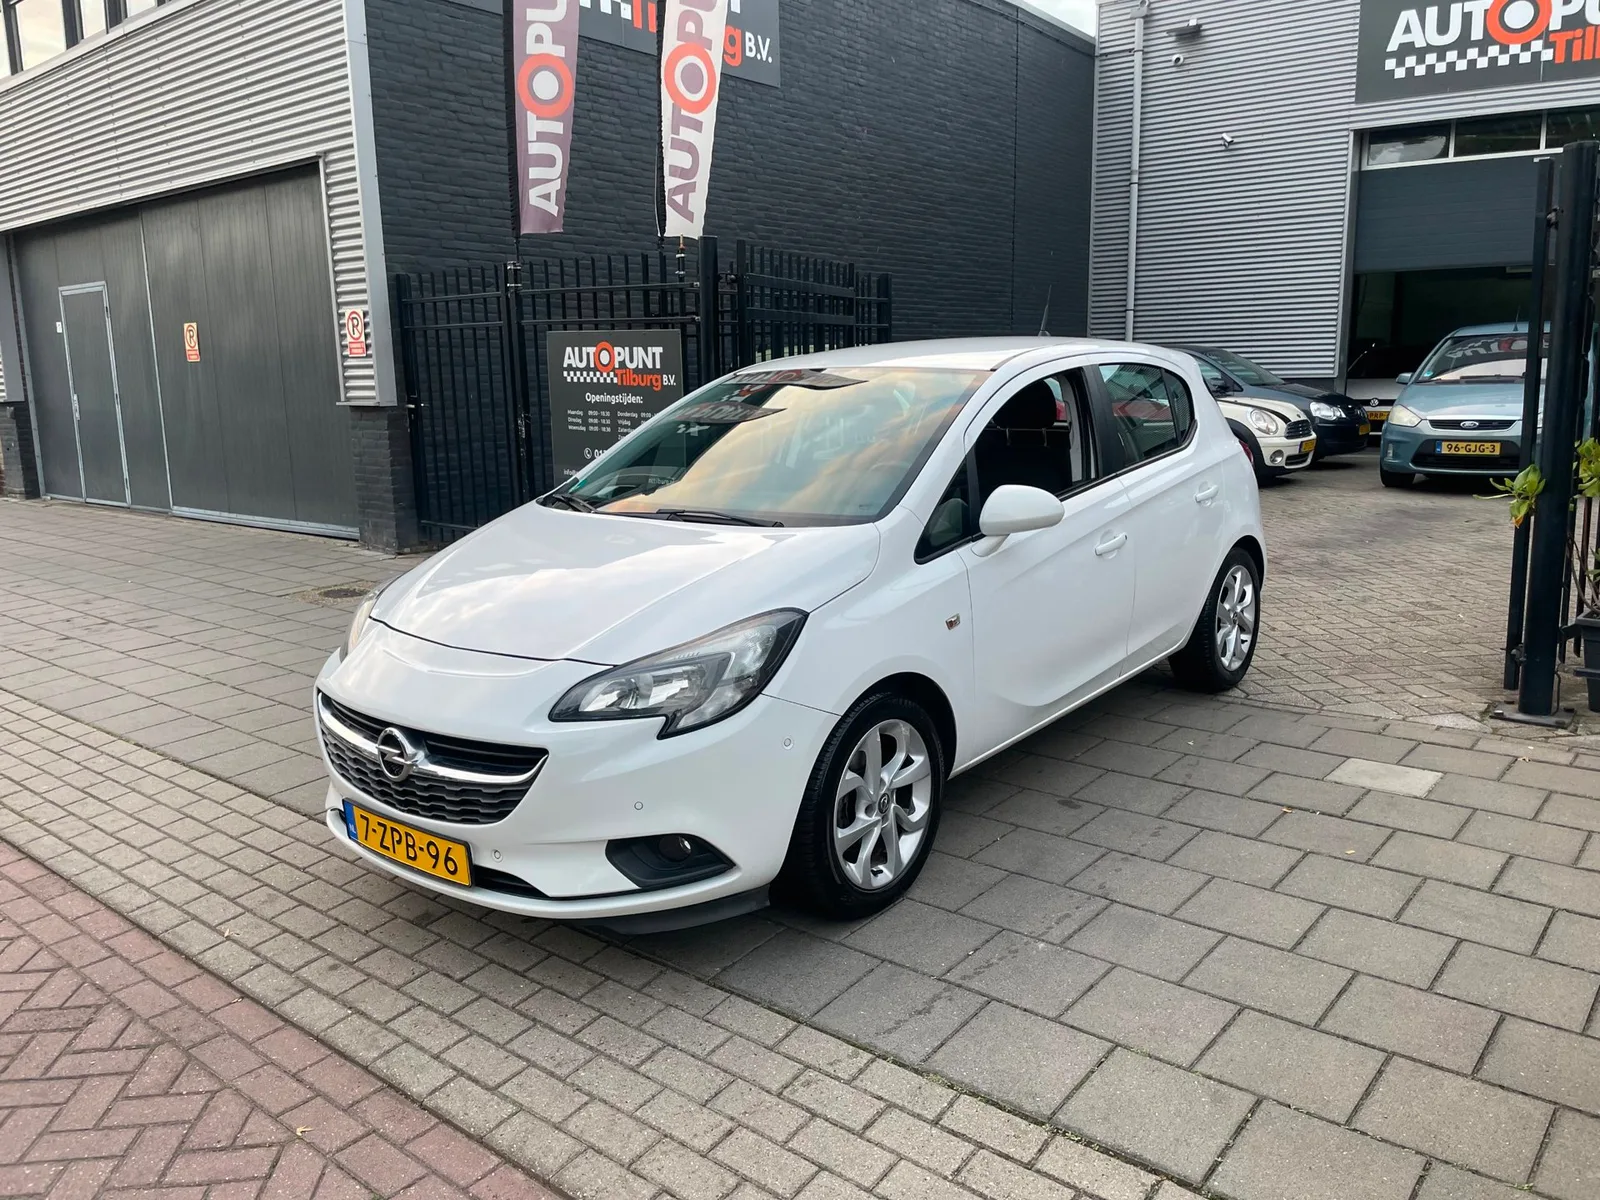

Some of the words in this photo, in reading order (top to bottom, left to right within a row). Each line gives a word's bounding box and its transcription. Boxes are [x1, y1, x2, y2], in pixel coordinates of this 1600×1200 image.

[745, 31, 773, 63] B.V.
[1549, 26, 1600, 64] Til
[563, 341, 664, 373] AUTOPUNT
[615, 369, 662, 391] Tilburg
[663, 374, 676, 386] B.V.
[585, 392, 644, 405] Openingstijden:
[617, 411, 638, 419] Donderdag
[617, 419, 631, 427] Vrijdag
[1446, 443, 1496, 453] 96-GJG-3
[360, 813, 458, 876] 7-ZPB-96
